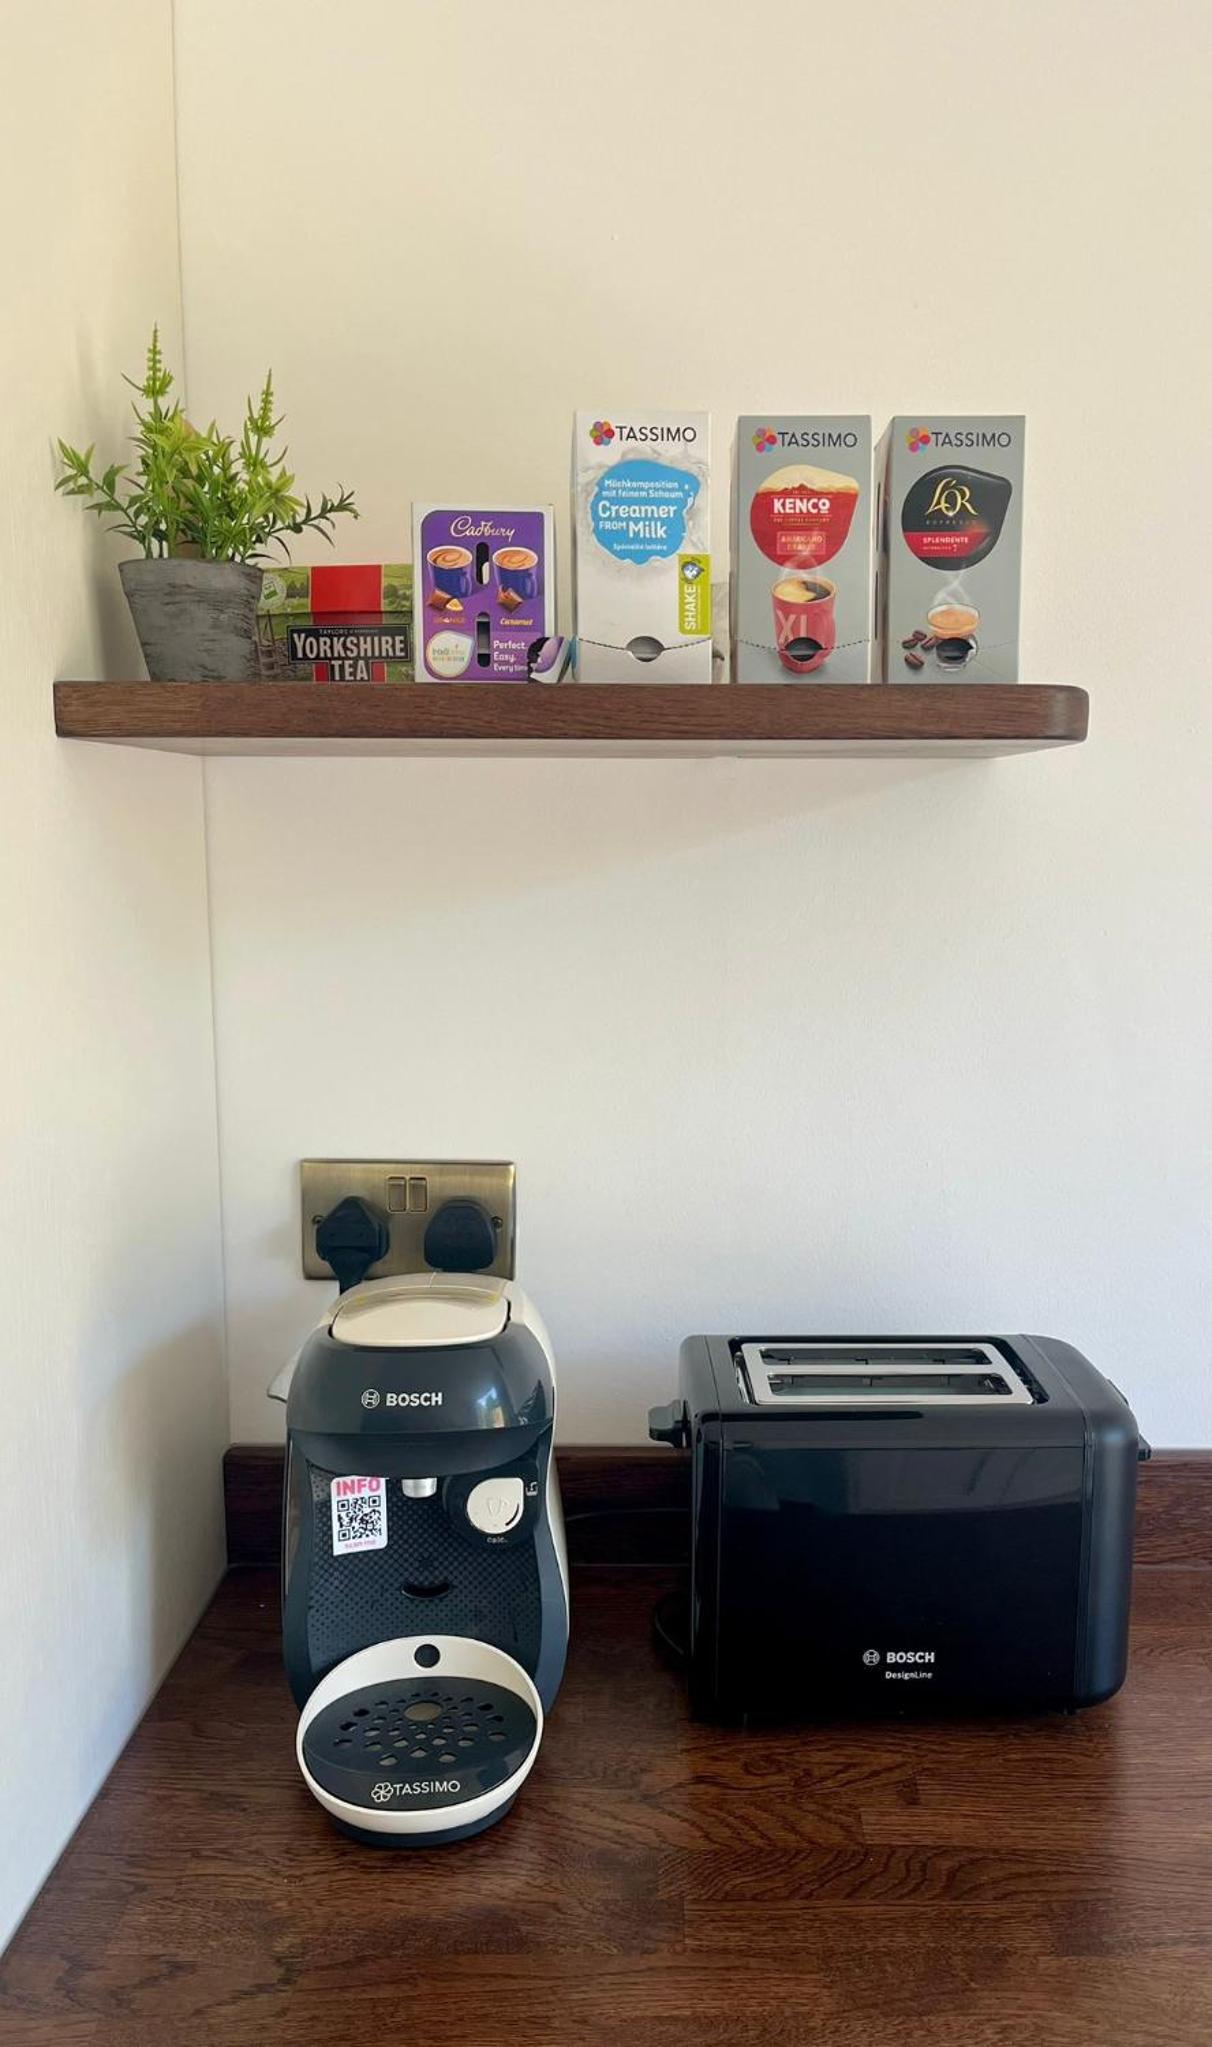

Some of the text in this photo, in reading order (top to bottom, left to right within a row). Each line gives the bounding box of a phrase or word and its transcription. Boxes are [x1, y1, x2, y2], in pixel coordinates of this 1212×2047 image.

[615, 426, 697, 443] TASSIMO
[777, 432, 858, 448] TASSIMO
[931, 432, 1012, 448] TASSIMO
[598, 500, 678, 518] Creamer
[773, 498, 831, 514] KENCO
[450, 515, 515, 542] Cadbury
[599, 520, 668, 539] FROM Milk
[684, 584, 696, 630] SHAKE
[293, 633, 405, 659] YORKSHIRE
[331, 660, 369, 680] TEA
[385, 1392, 443, 1407] BOSCH
[335, 1477, 381, 1497] INFO
[886, 1651, 936, 1664] BOSCH
[885, 1671, 933, 1680] DesignLine
[393, 1780, 461, 1796] TASSIMO
